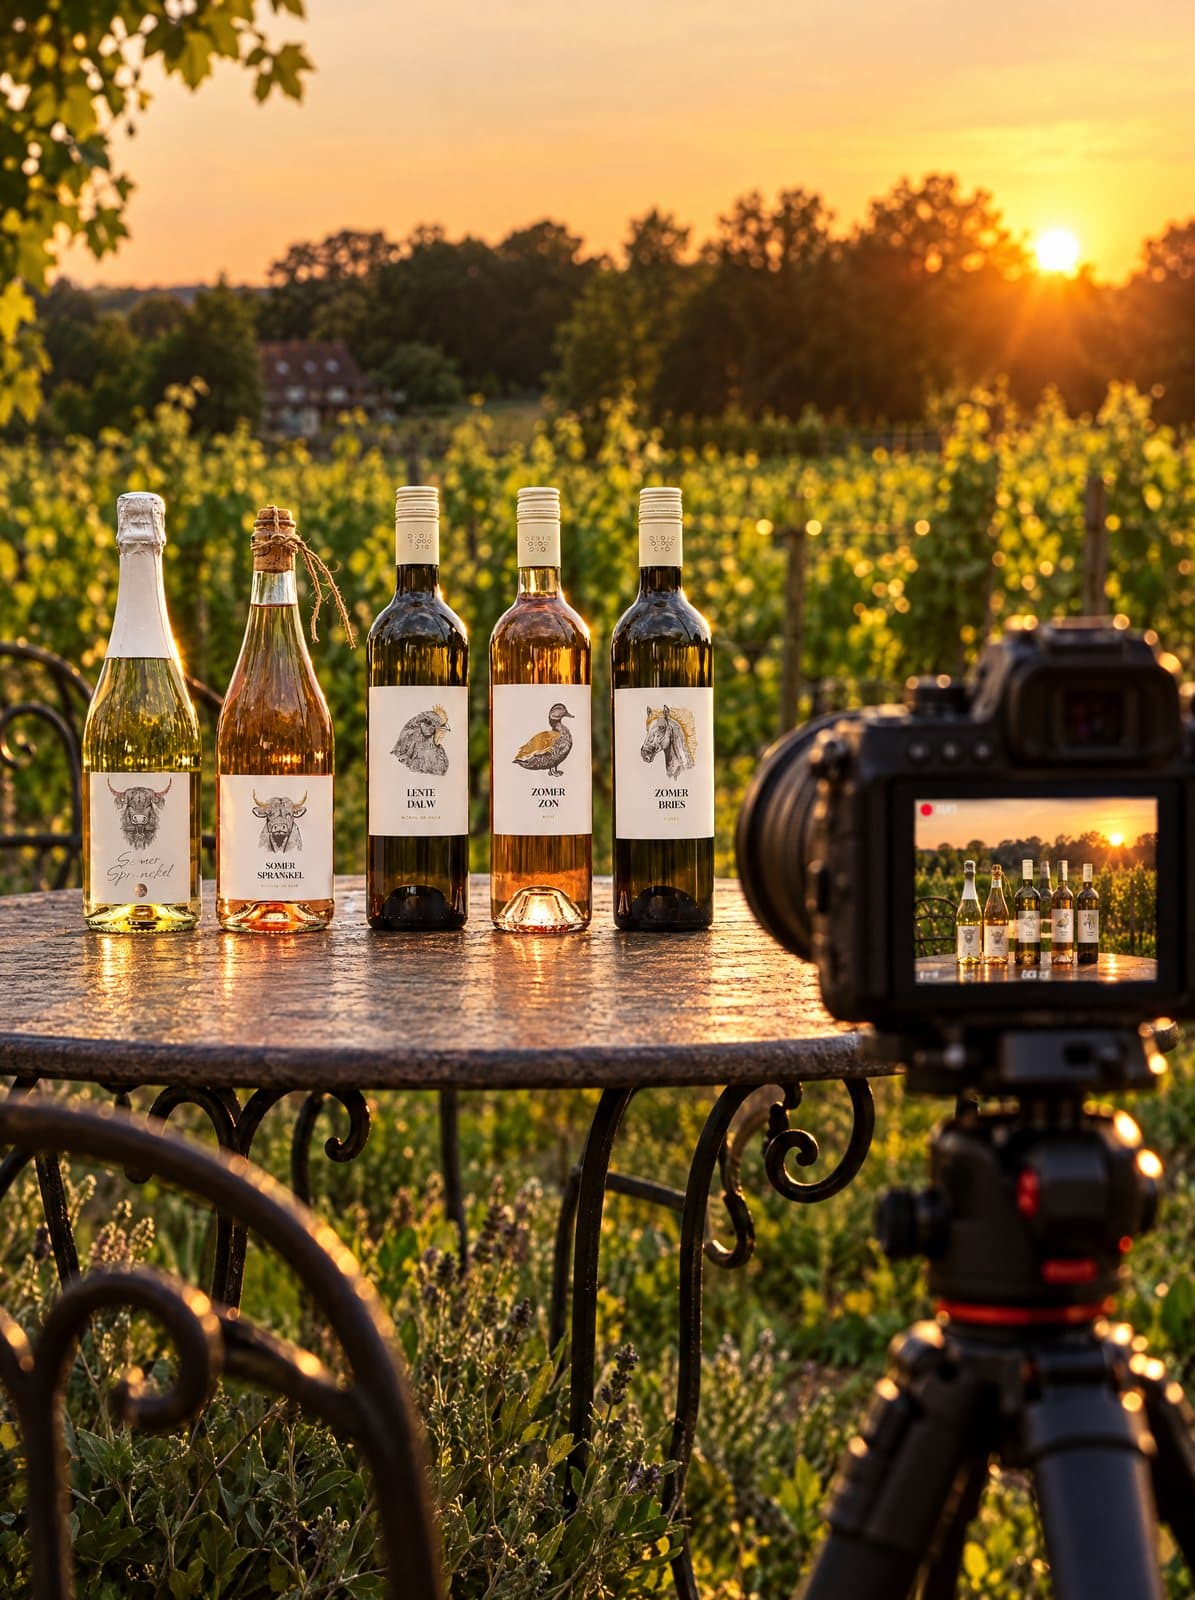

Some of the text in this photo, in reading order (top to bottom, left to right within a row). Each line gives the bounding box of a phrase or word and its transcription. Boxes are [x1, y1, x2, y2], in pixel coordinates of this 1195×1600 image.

[407, 788, 436, 797] LENTE
[531, 788, 565, 796] ZOMER
[654, 788, 688, 798] ZOMER
[538, 800, 559, 808] ZON
[658, 800, 686, 808] BRIES
[265, 862, 296, 870] SOMER
